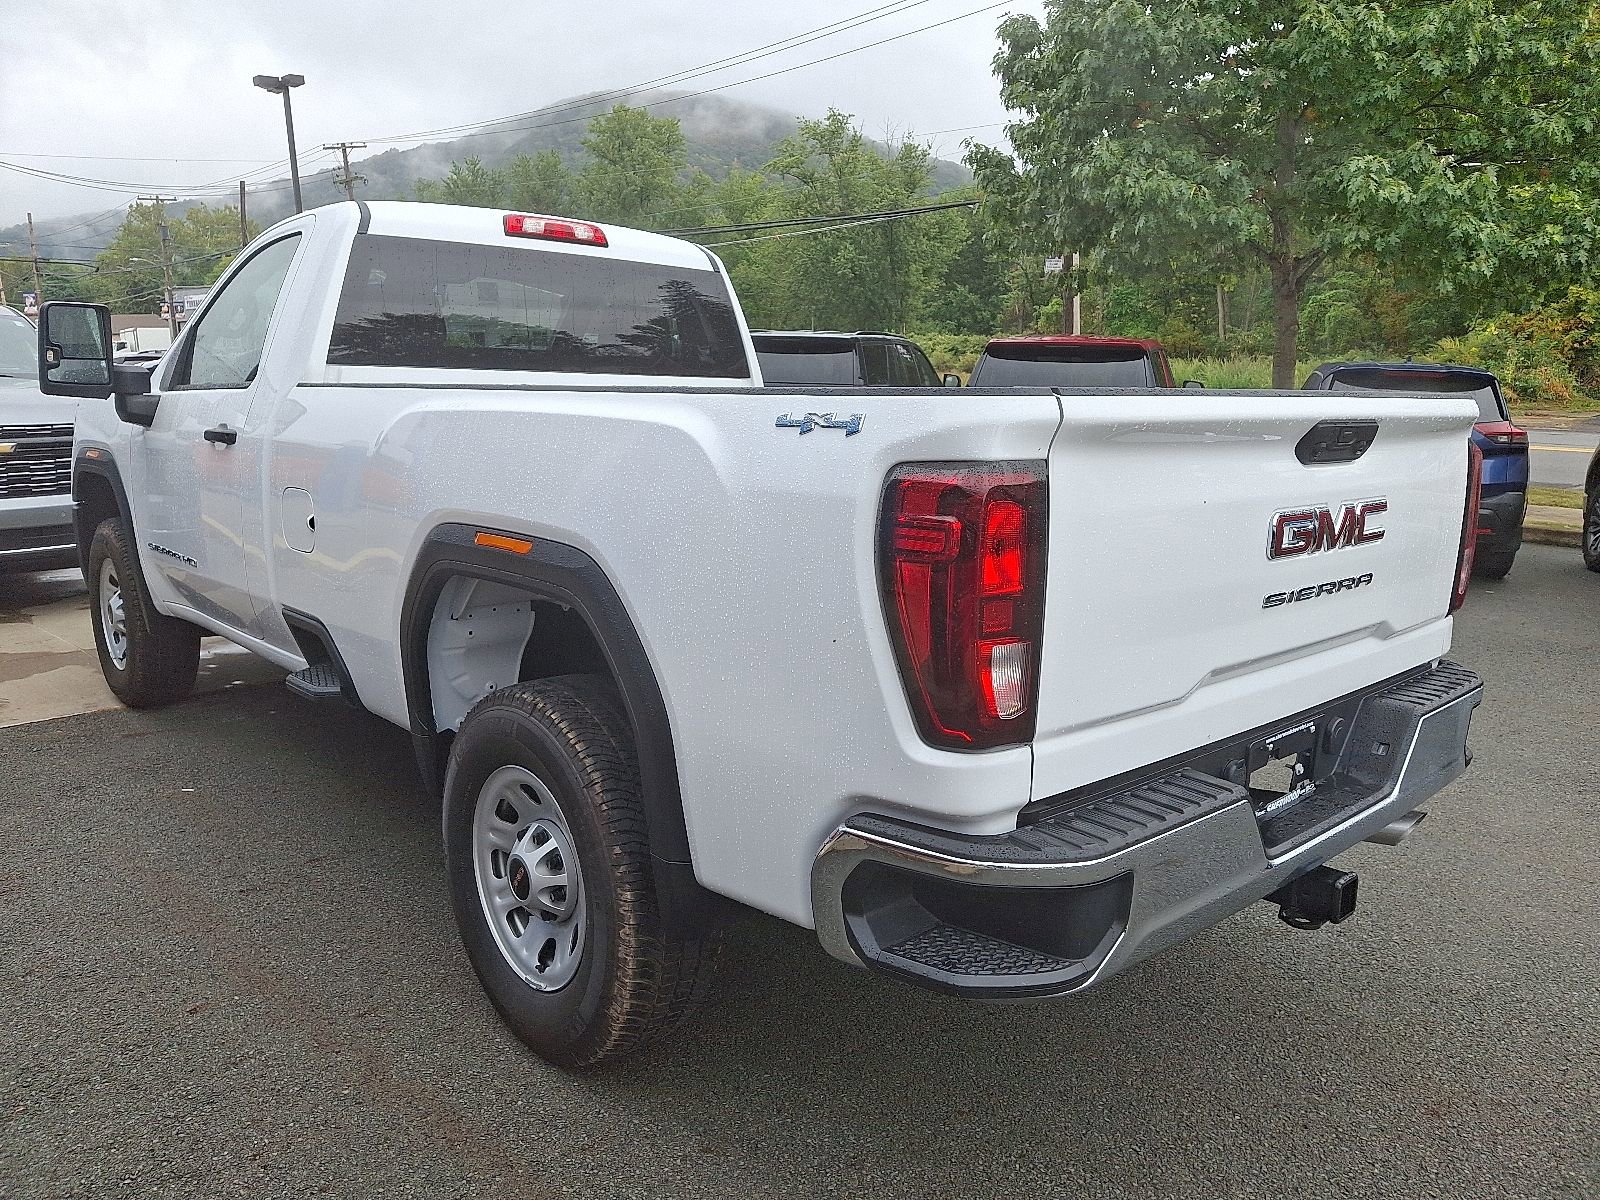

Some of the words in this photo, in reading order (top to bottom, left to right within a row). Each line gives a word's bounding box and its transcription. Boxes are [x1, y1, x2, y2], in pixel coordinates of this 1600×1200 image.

[1266, 497, 1388, 561] GMC
[147, 542, 182, 561] SIERRA
[1262, 572, 1374, 609] SIERRA
